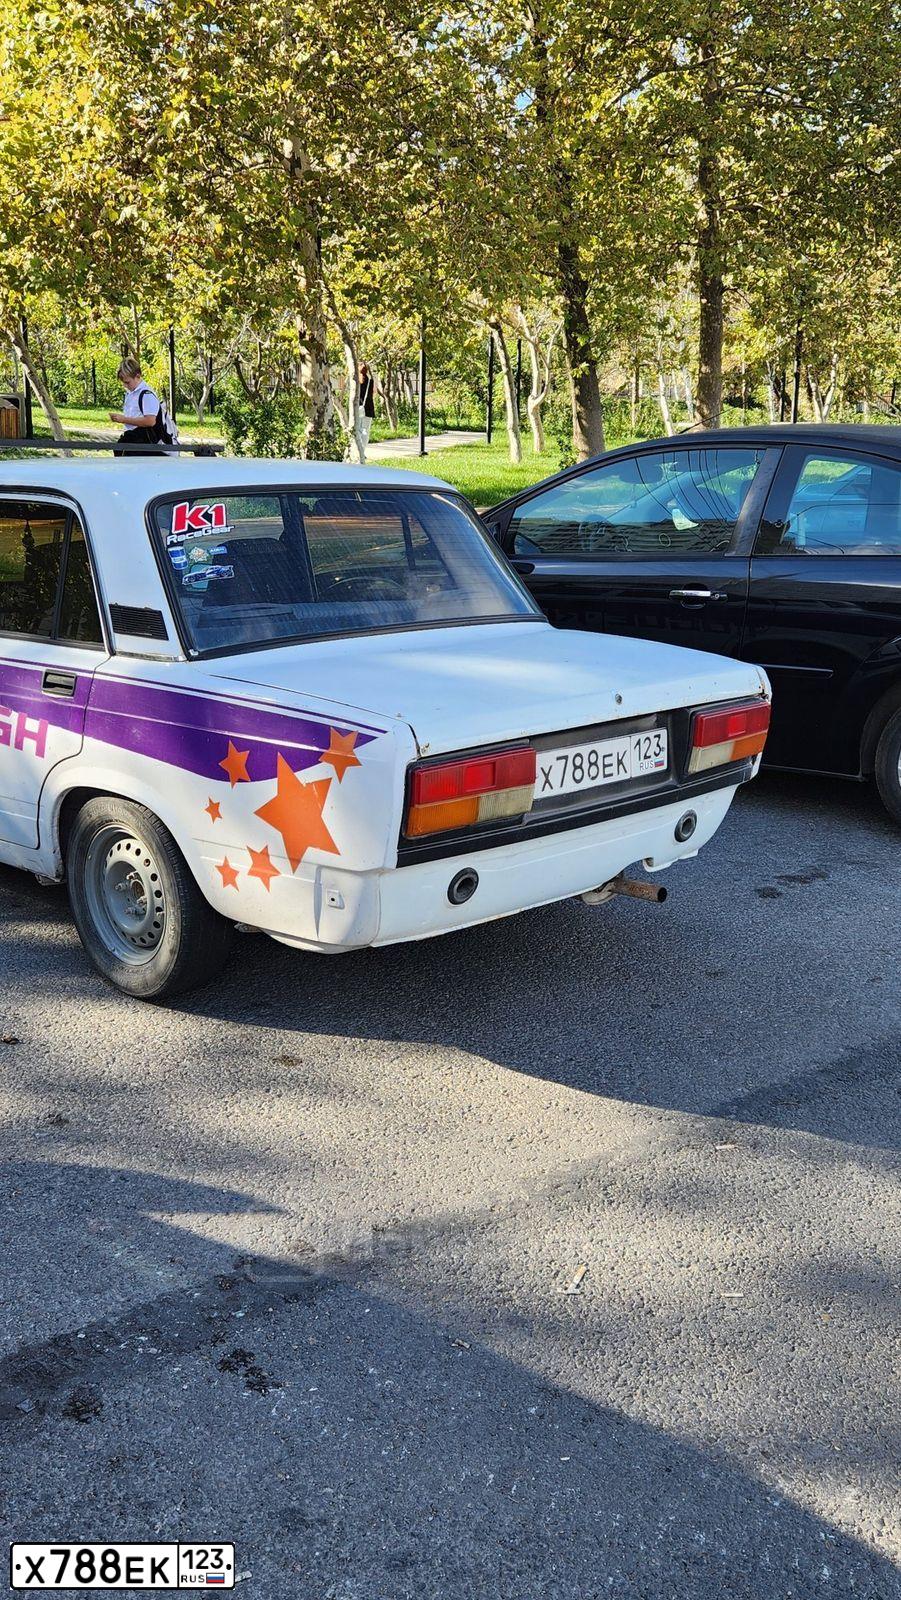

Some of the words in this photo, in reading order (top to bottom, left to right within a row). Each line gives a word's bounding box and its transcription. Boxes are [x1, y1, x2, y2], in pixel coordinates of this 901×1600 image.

[172, 502, 226, 534] K1
[166, 525, 235, 546] RaceGear
[634, 734, 662, 762] 123
[639, 760, 655, 771] RUS
